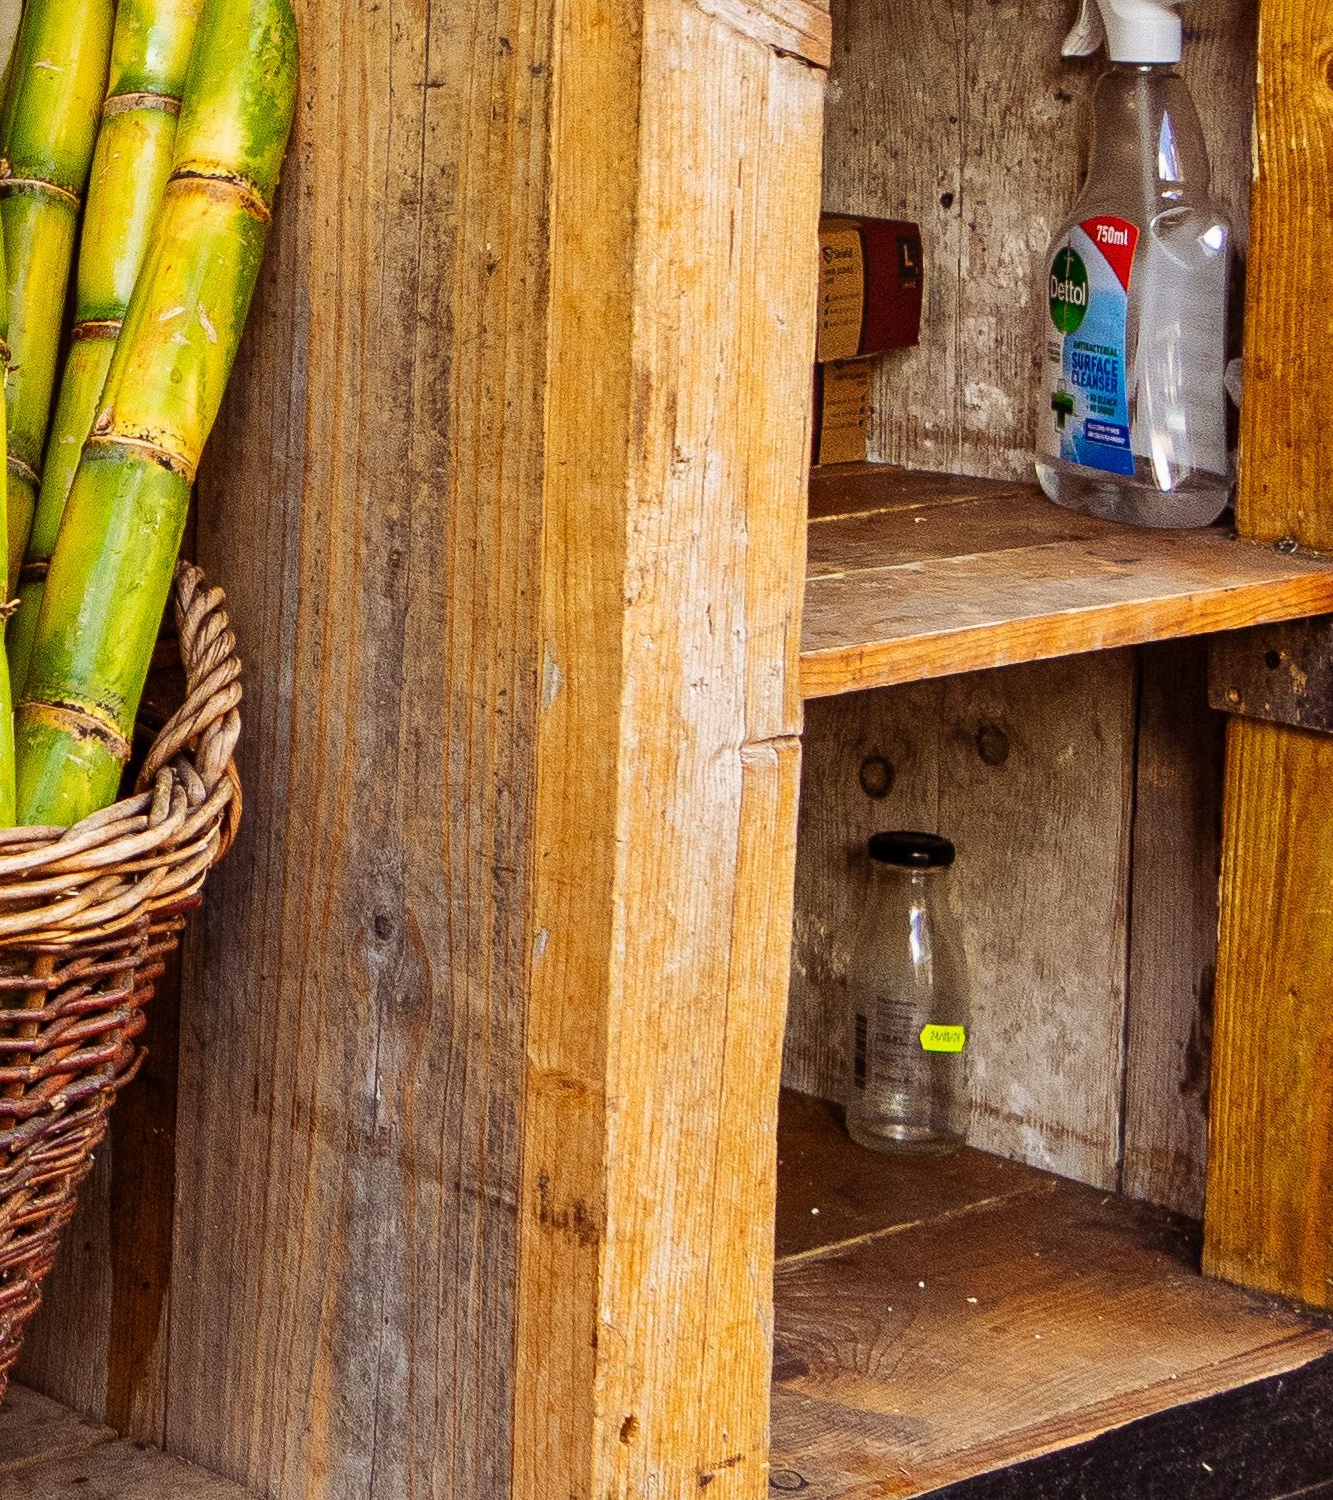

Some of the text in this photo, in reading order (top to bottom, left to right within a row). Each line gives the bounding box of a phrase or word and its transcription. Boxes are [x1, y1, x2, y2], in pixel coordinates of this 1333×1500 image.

[1096, 224, 1129, 247] 750ml
[1049, 274, 1086, 306] Dettol
[1071, 351, 1119, 379] SURFACE
[1070, 369, 1119, 395] CLEANSER
